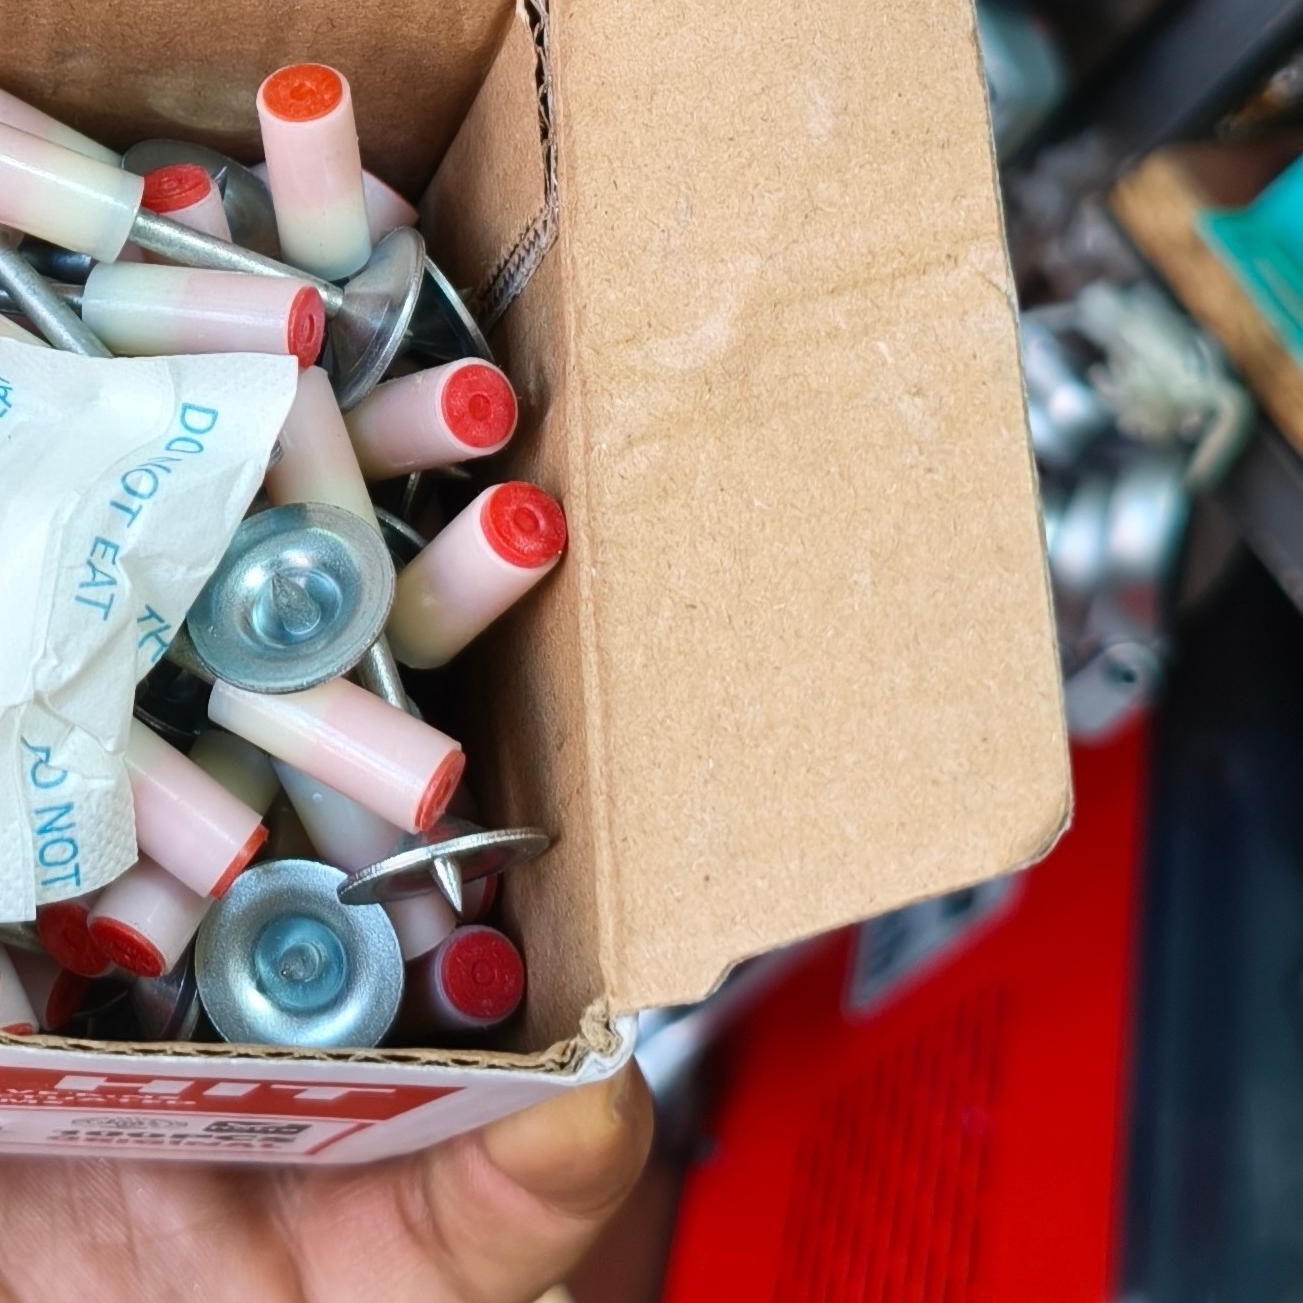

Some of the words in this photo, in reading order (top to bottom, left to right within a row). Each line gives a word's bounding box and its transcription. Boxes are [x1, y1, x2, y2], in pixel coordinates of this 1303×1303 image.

[165, 402, 219, 454] DO
[109, 456, 183, 529] NOT
[75, 536, 120, 621] EAT
[34, 802, 81, 887] NOT
[53, 1074, 397, 1101] HIT
